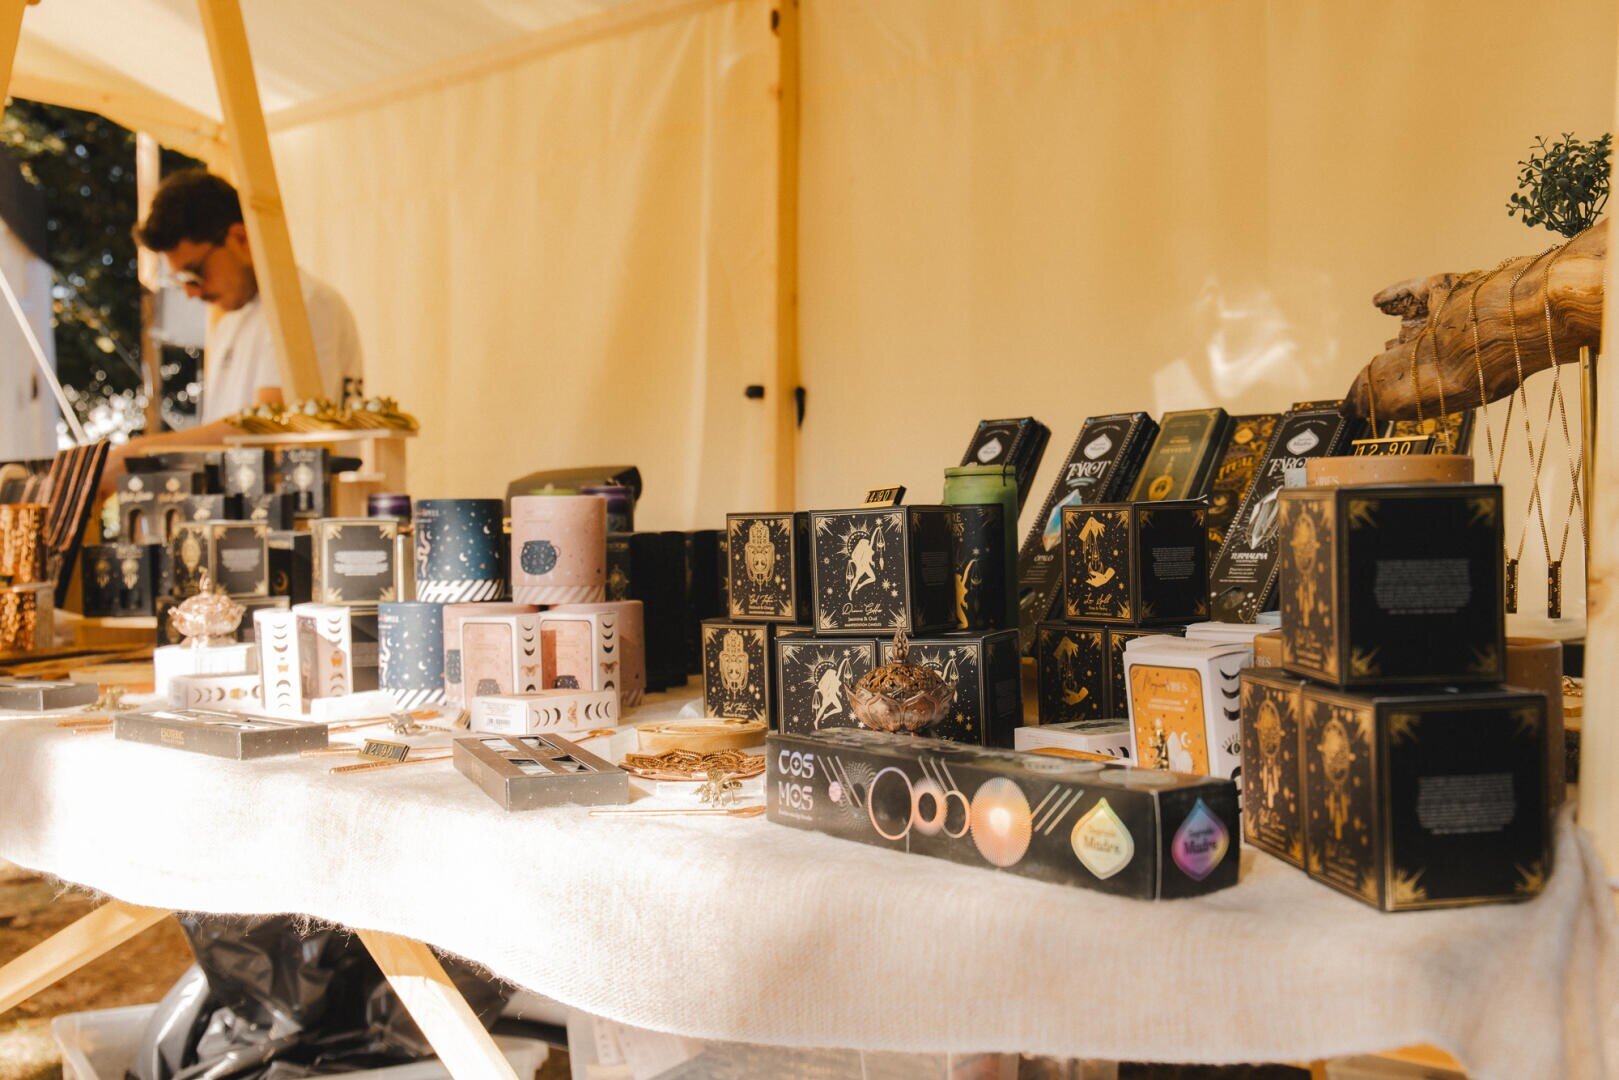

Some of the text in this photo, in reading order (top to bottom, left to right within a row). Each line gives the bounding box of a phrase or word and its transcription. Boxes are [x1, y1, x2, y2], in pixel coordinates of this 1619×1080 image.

[1358, 441, 1412, 457] 12.90
[1066, 460, 1112, 481] TAROT
[778, 749, 815, 779] COS
[778, 780, 814, 811] MOS
